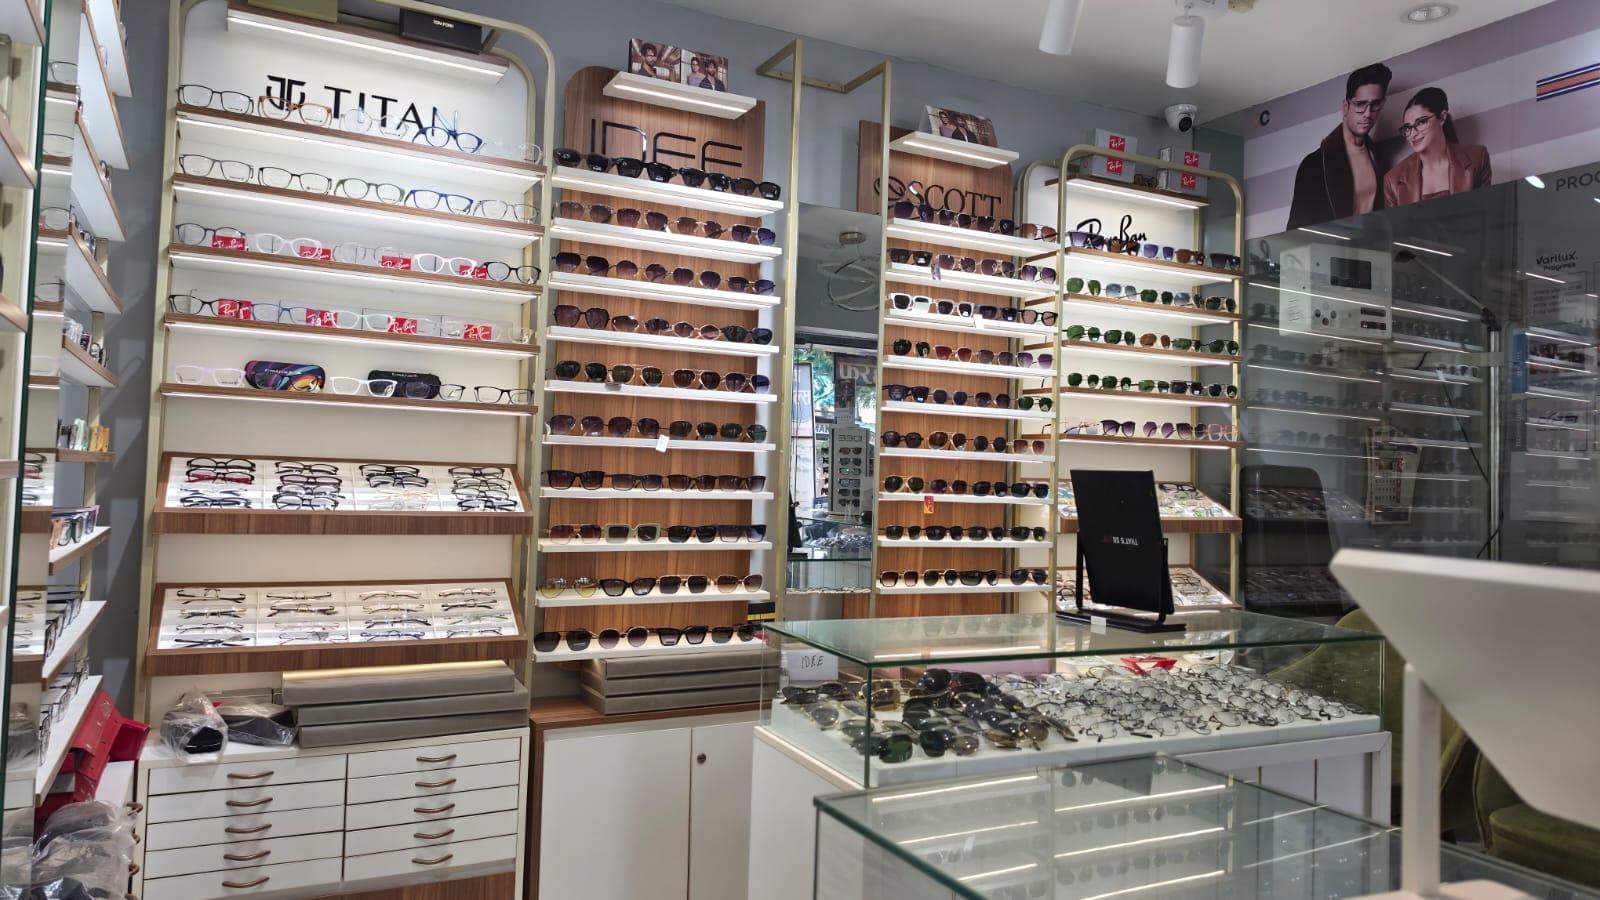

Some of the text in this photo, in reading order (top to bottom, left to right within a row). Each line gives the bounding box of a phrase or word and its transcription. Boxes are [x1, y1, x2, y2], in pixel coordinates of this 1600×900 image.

[324, 86, 459, 137] TITAN
[908, 180, 1002, 218] SCOTT
[1536, 250, 1577, 265] Varilux
[801, 654, 824, 669] IDEE
